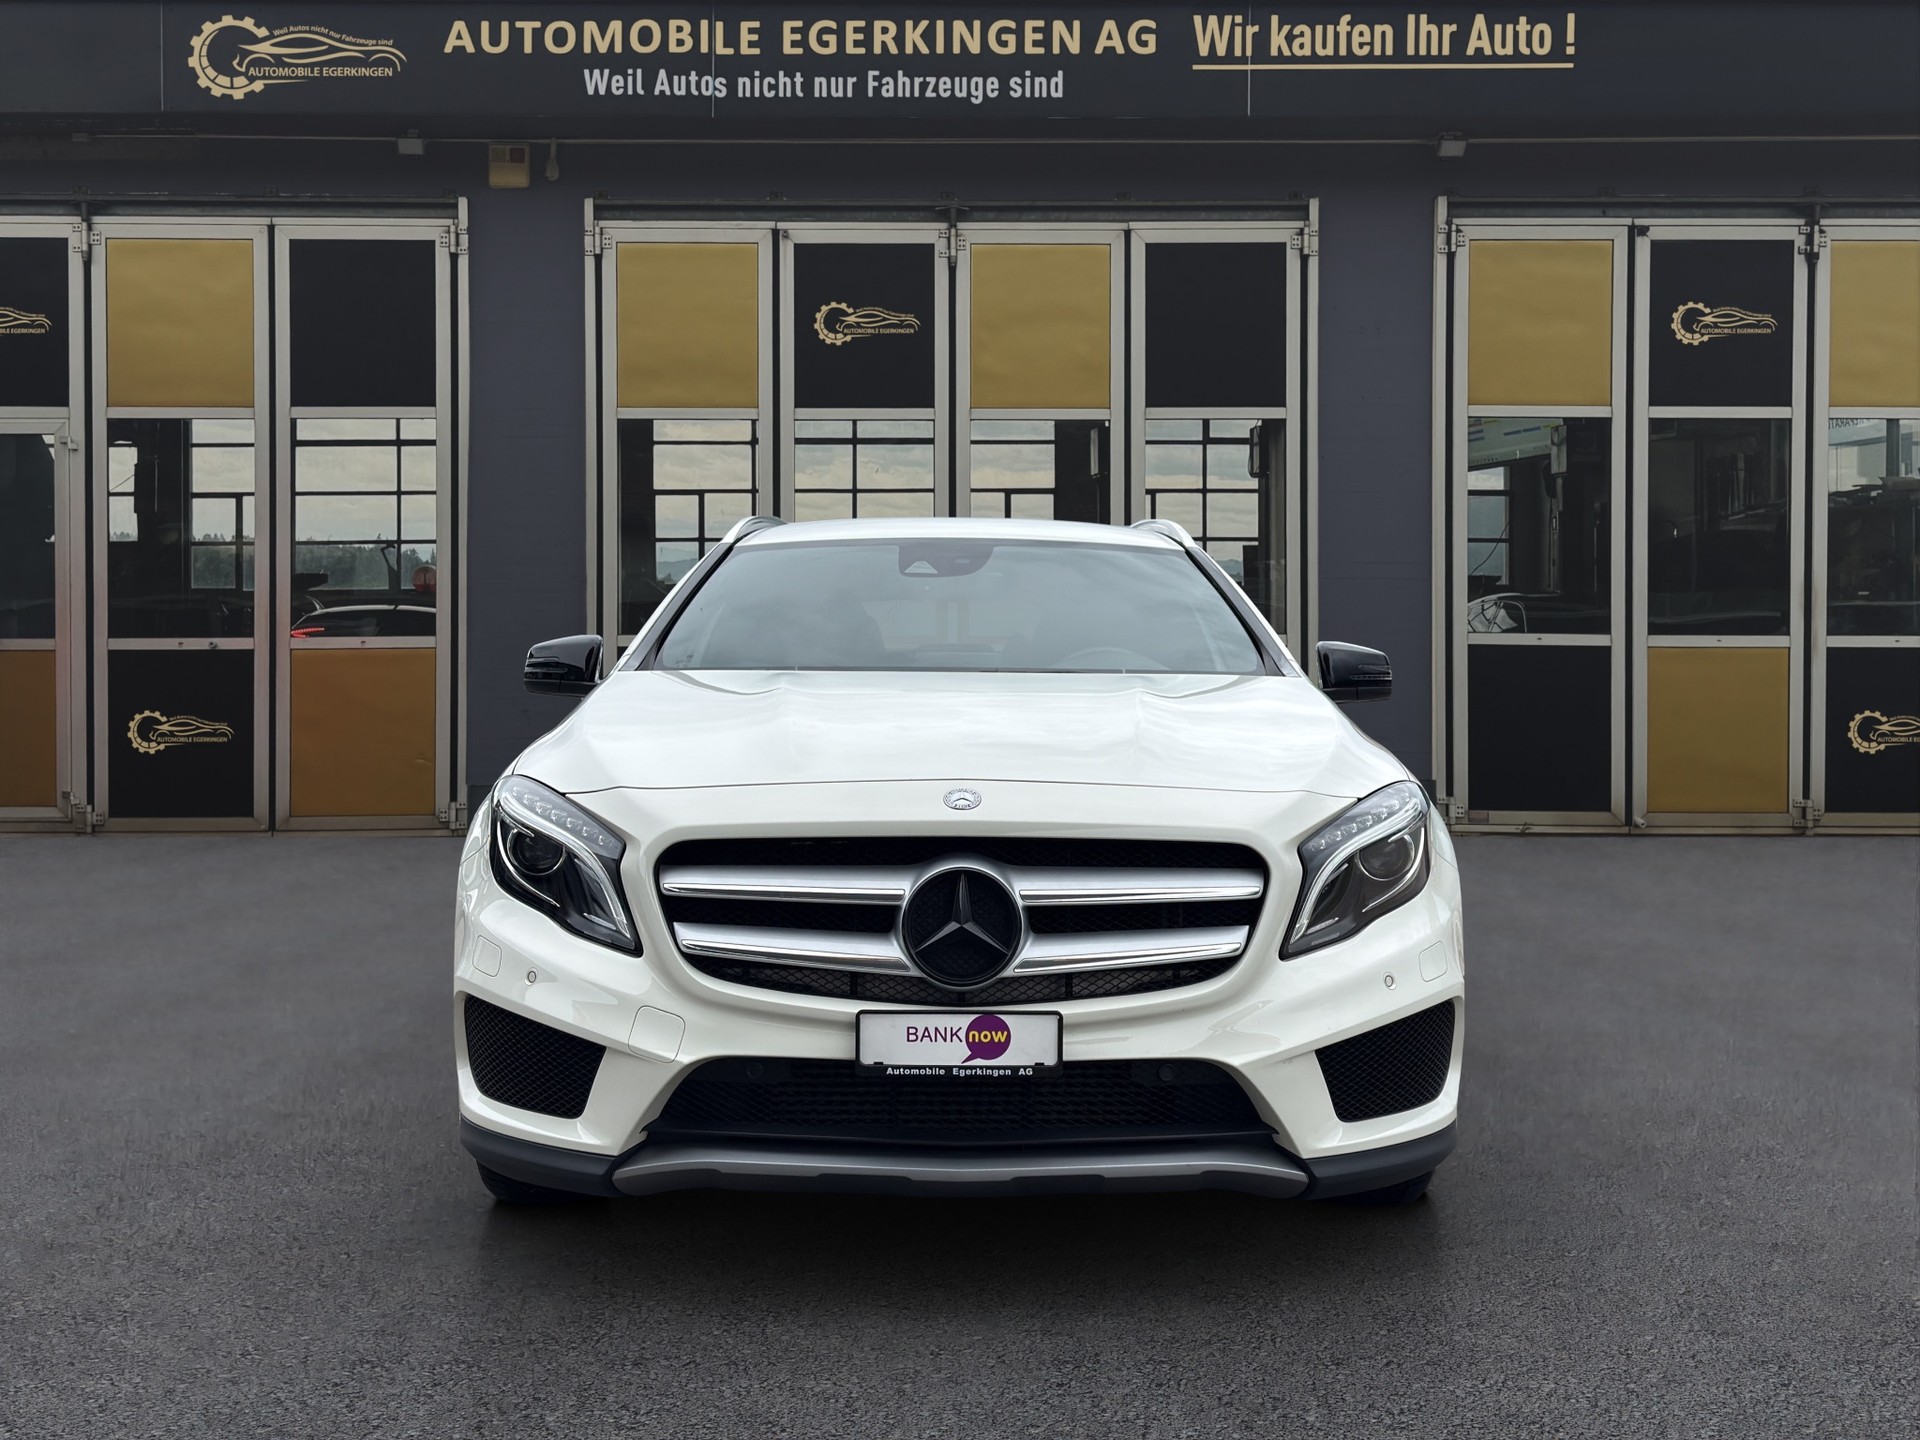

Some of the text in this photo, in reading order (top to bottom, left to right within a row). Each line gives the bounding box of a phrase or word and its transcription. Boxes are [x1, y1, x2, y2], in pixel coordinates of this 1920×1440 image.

[272, 27, 288, 37] Weil
[310, 25, 329, 35] nicht
[329, 31, 341, 39] nur
[341, 34, 377, 45] Fahrzeuge
[443, 19, 1158, 55] AUTOMOBILE EGERKINGEN AG
[1192, 14, 1260, 57] Wir
[1270, 13, 1394, 57] kaufen
[1406, 13, 1458, 56] Ihr
[1465, 13, 1552, 56] Auto
[248, 67, 393, 77] AUTOMOBILE EGERKINGEN
[583, 68, 1064, 105] Weil Autos nicht nur Fahrzeuge sind
[906, 1026, 1008, 1043] BANK now
[886, 1067, 1033, 1077] Automobile Egerkingen AG
